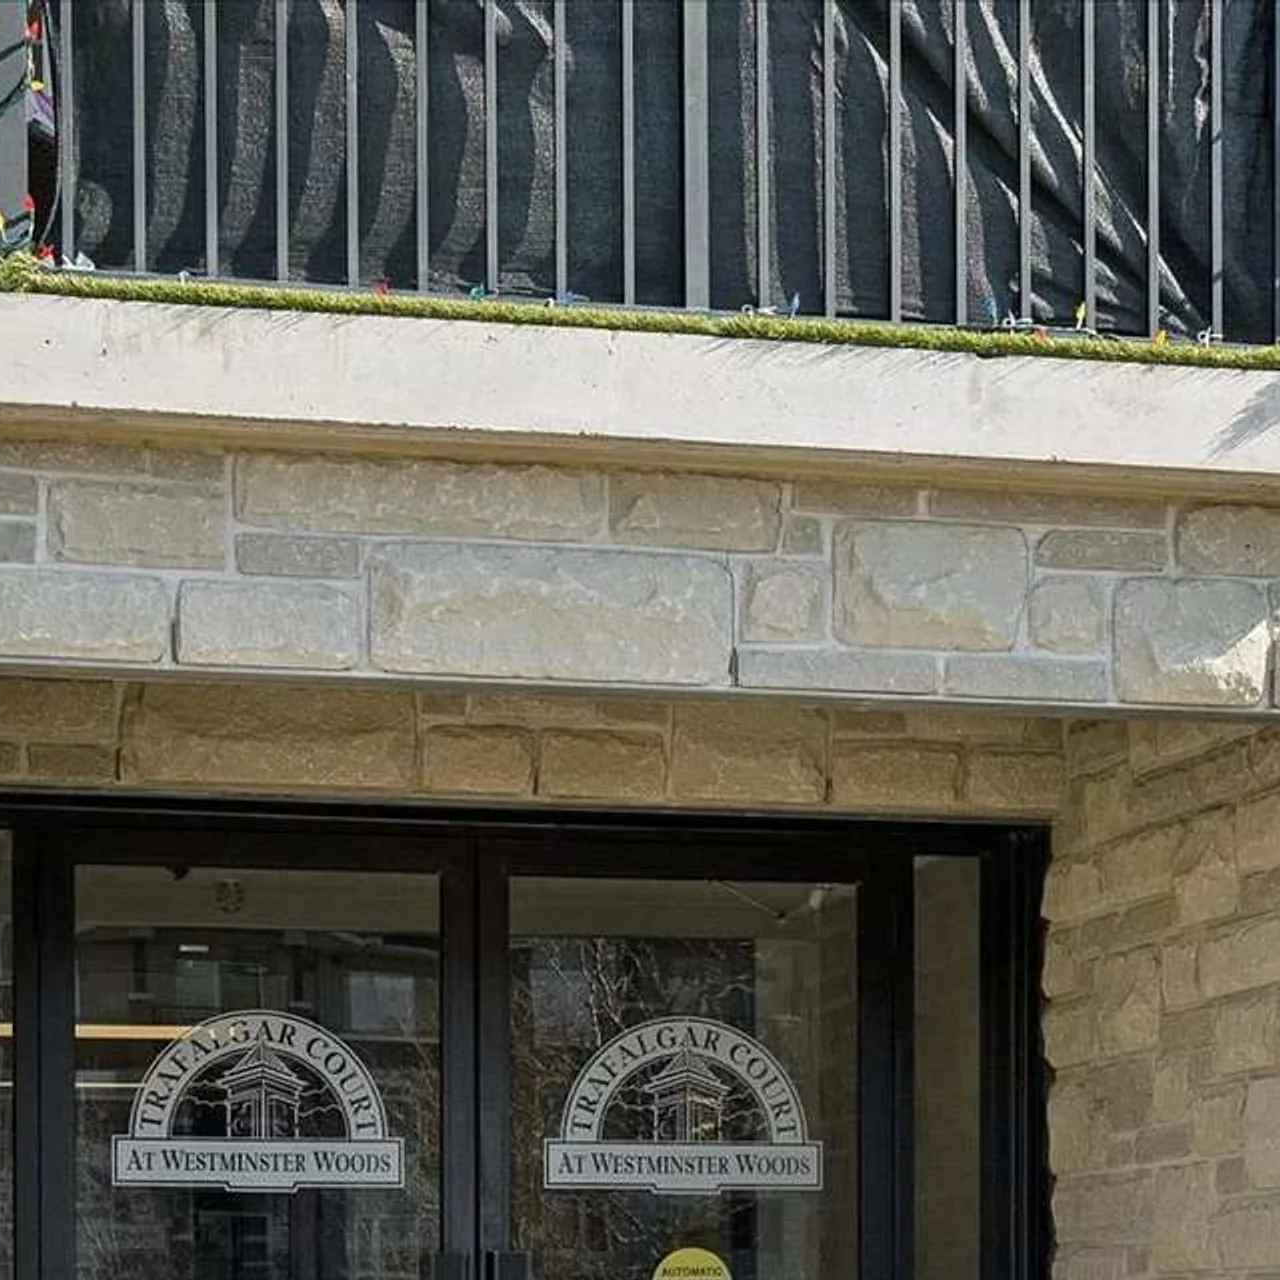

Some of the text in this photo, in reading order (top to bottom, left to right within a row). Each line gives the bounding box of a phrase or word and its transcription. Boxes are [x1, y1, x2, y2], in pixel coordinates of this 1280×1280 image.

[140, 1020, 378, 1136] TRAFALGAR COURT
[571, 1026, 798, 1138] TRAFALGAR COURT
[314, 1150, 391, 1173] WOODS
[735, 1153, 812, 1176] WOODS
[661, 1266, 723, 1278] AUTOMATIC
